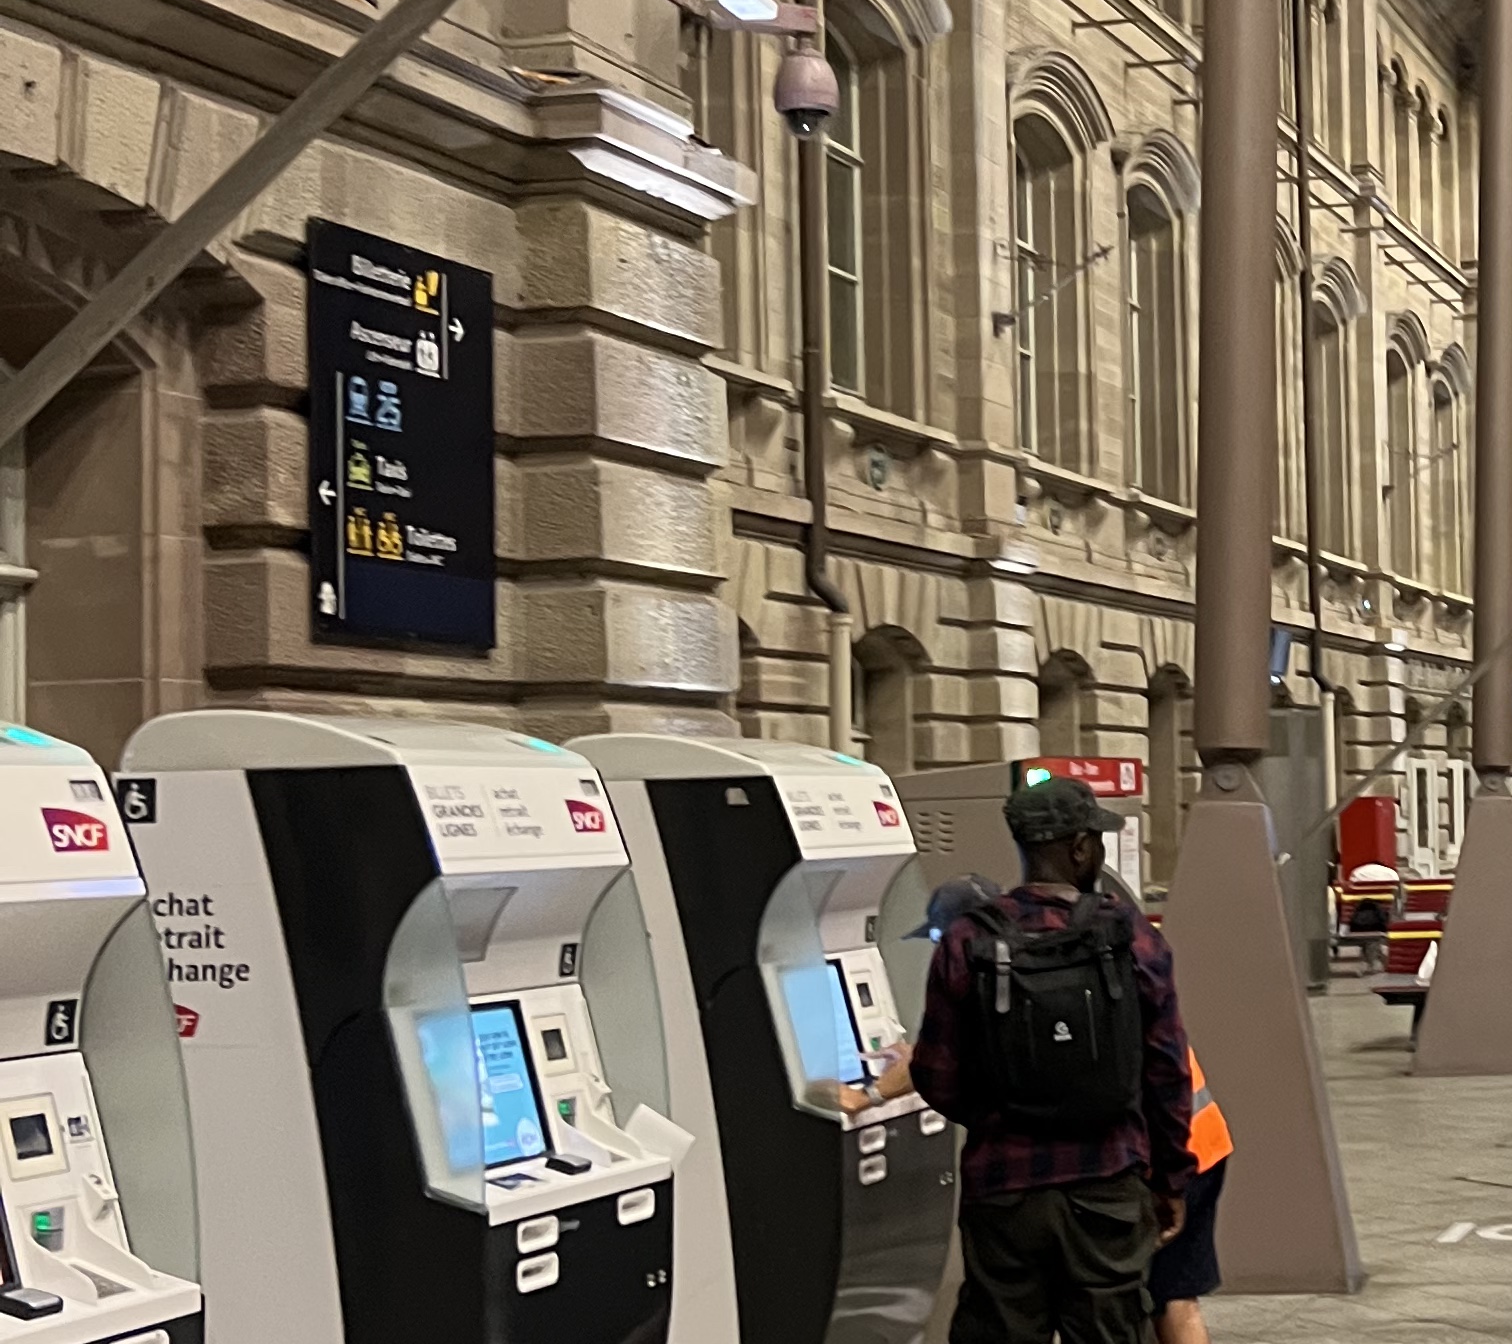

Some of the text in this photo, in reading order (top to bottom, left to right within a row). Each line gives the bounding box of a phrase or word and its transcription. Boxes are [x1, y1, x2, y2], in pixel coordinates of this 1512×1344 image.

[572, 811, 603, 830] SNCF
[52, 823, 104, 848] SNCF
[153, 892, 214, 918] chat
[163, 924, 225, 950] trait
[168, 959, 250, 989] hange
